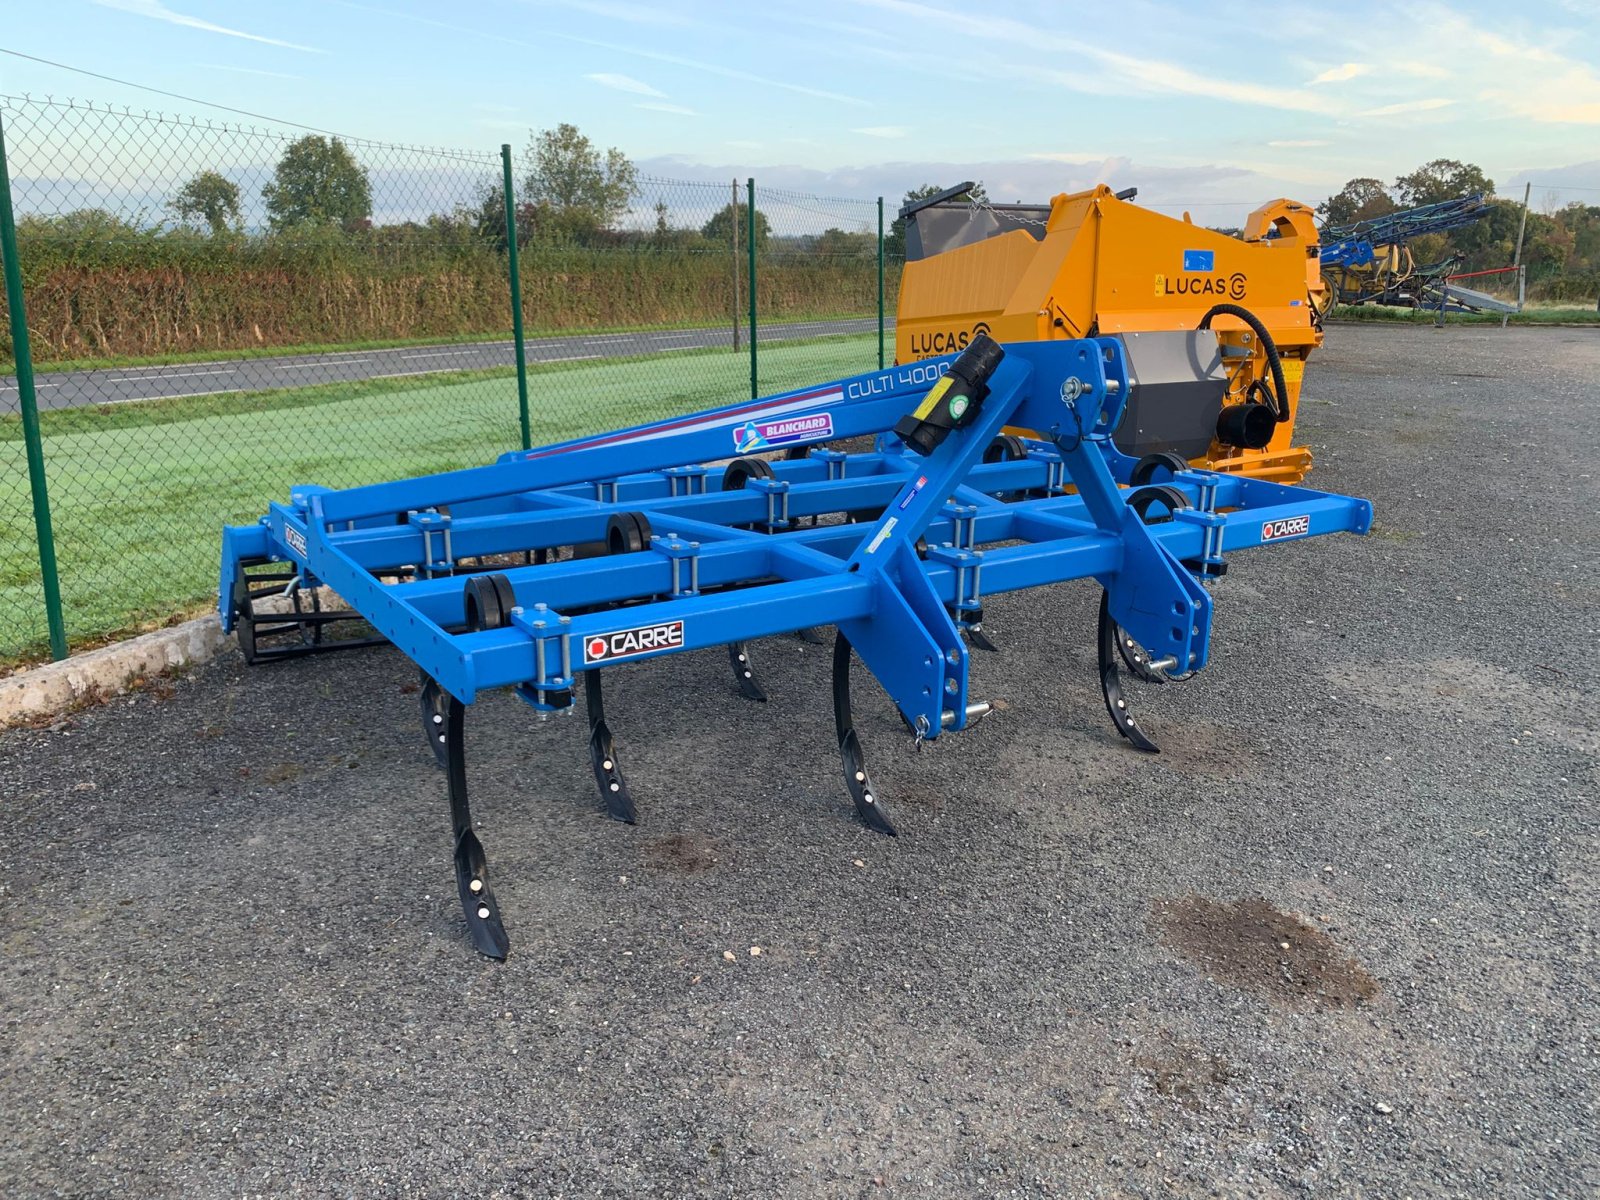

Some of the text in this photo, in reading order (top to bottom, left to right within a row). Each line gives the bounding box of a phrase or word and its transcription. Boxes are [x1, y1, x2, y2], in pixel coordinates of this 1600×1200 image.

[1165, 278, 1226, 295] LUCAS
[911, 331, 969, 354] LUCAS
[848, 374, 894, 399] CULTI
[899, 362, 951, 385] 4000
[766, 417, 826, 437] BLANCHARD
